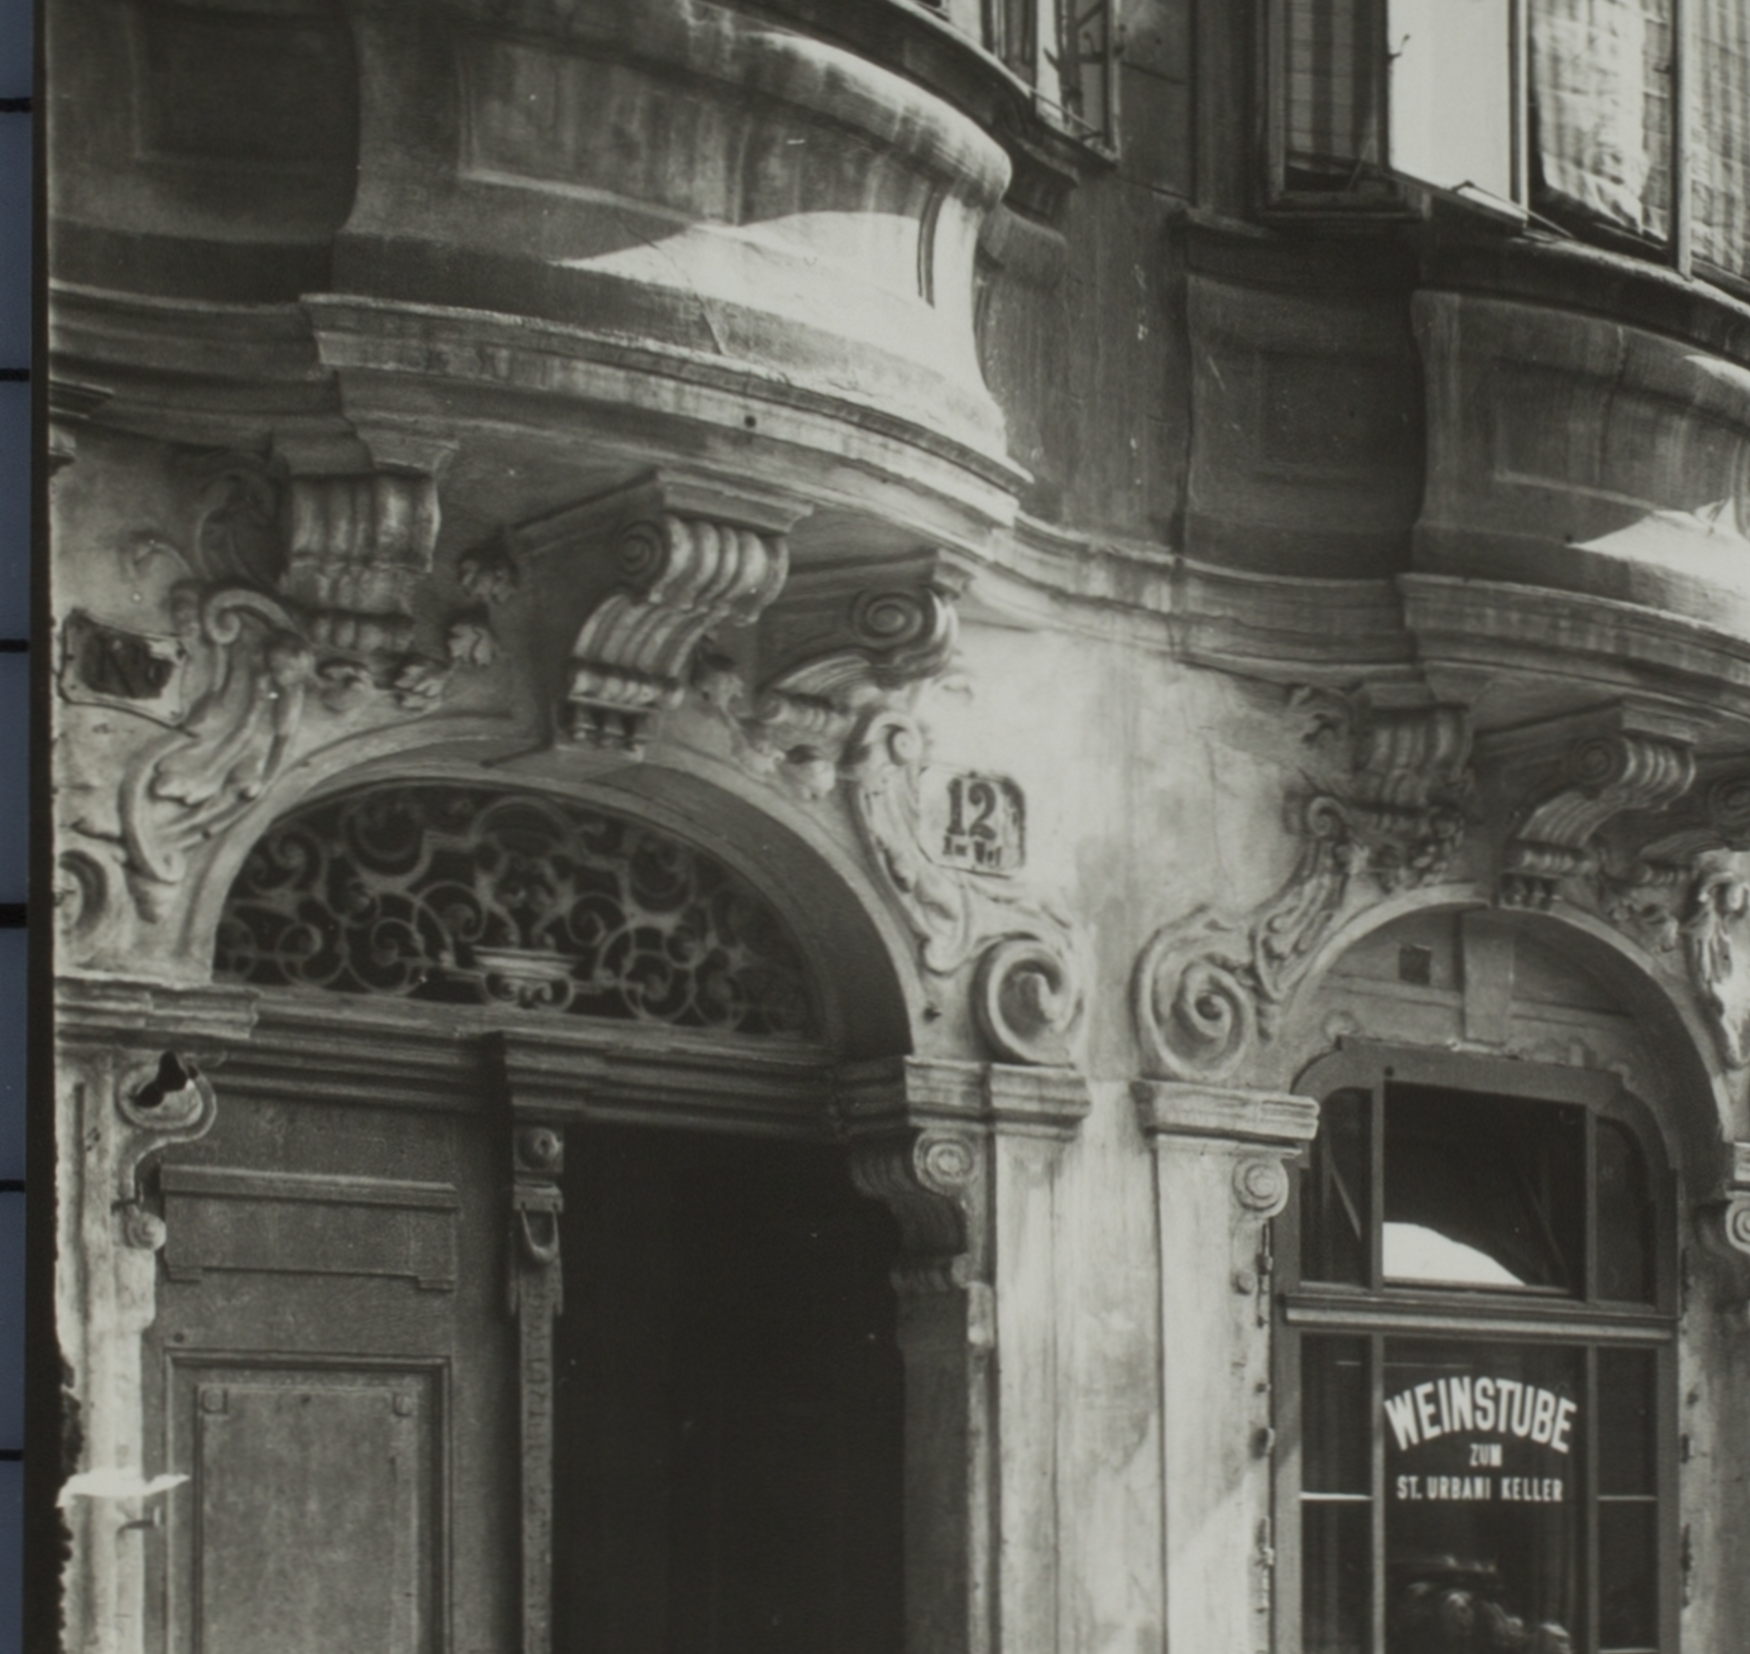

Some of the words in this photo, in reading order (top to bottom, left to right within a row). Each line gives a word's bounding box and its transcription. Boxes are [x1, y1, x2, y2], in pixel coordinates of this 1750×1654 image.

[947, 778, 997, 840] 12
[1384, 1376, 1578, 1454] WEINSTUBE
[1469, 1444, 1503, 1467] ZUM
[1397, 1476, 1423, 1500] ST.
[1427, 1476, 1492, 1500] URBANI
[1501, 1478, 1564, 1503] KELLER
